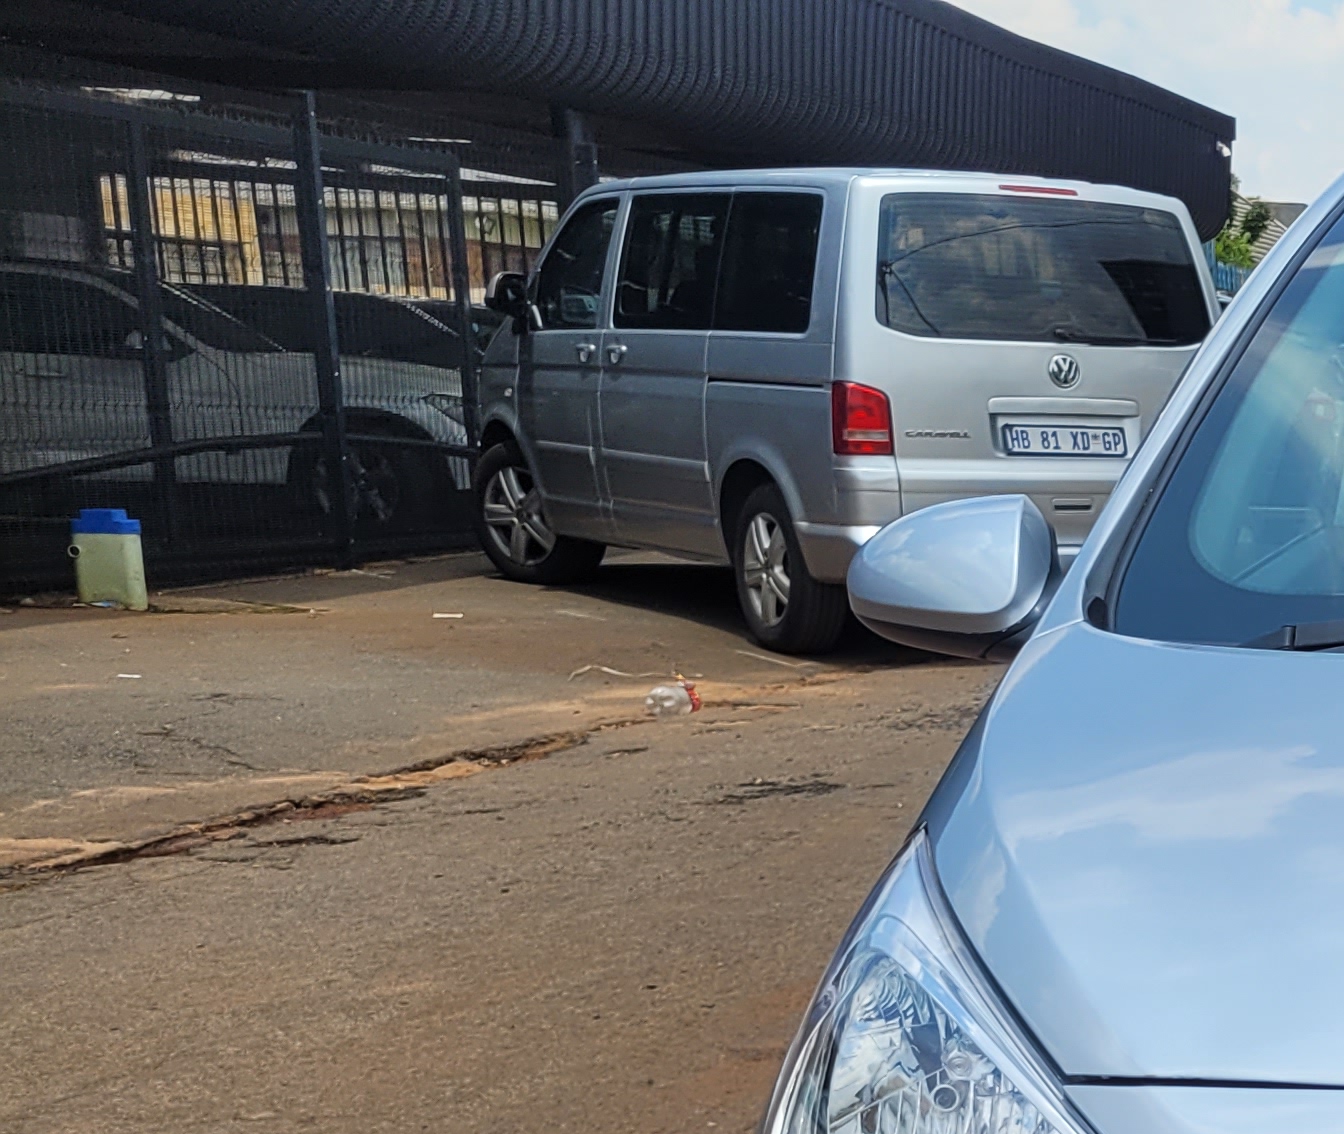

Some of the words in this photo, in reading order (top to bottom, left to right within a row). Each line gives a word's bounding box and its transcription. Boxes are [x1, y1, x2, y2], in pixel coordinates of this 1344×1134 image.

[1009, 429, 1031, 449] HB
[1040, 430, 1062, 450] 81
[1070, 431, 1091, 451] XD
[1101, 432, 1121, 452] GP
